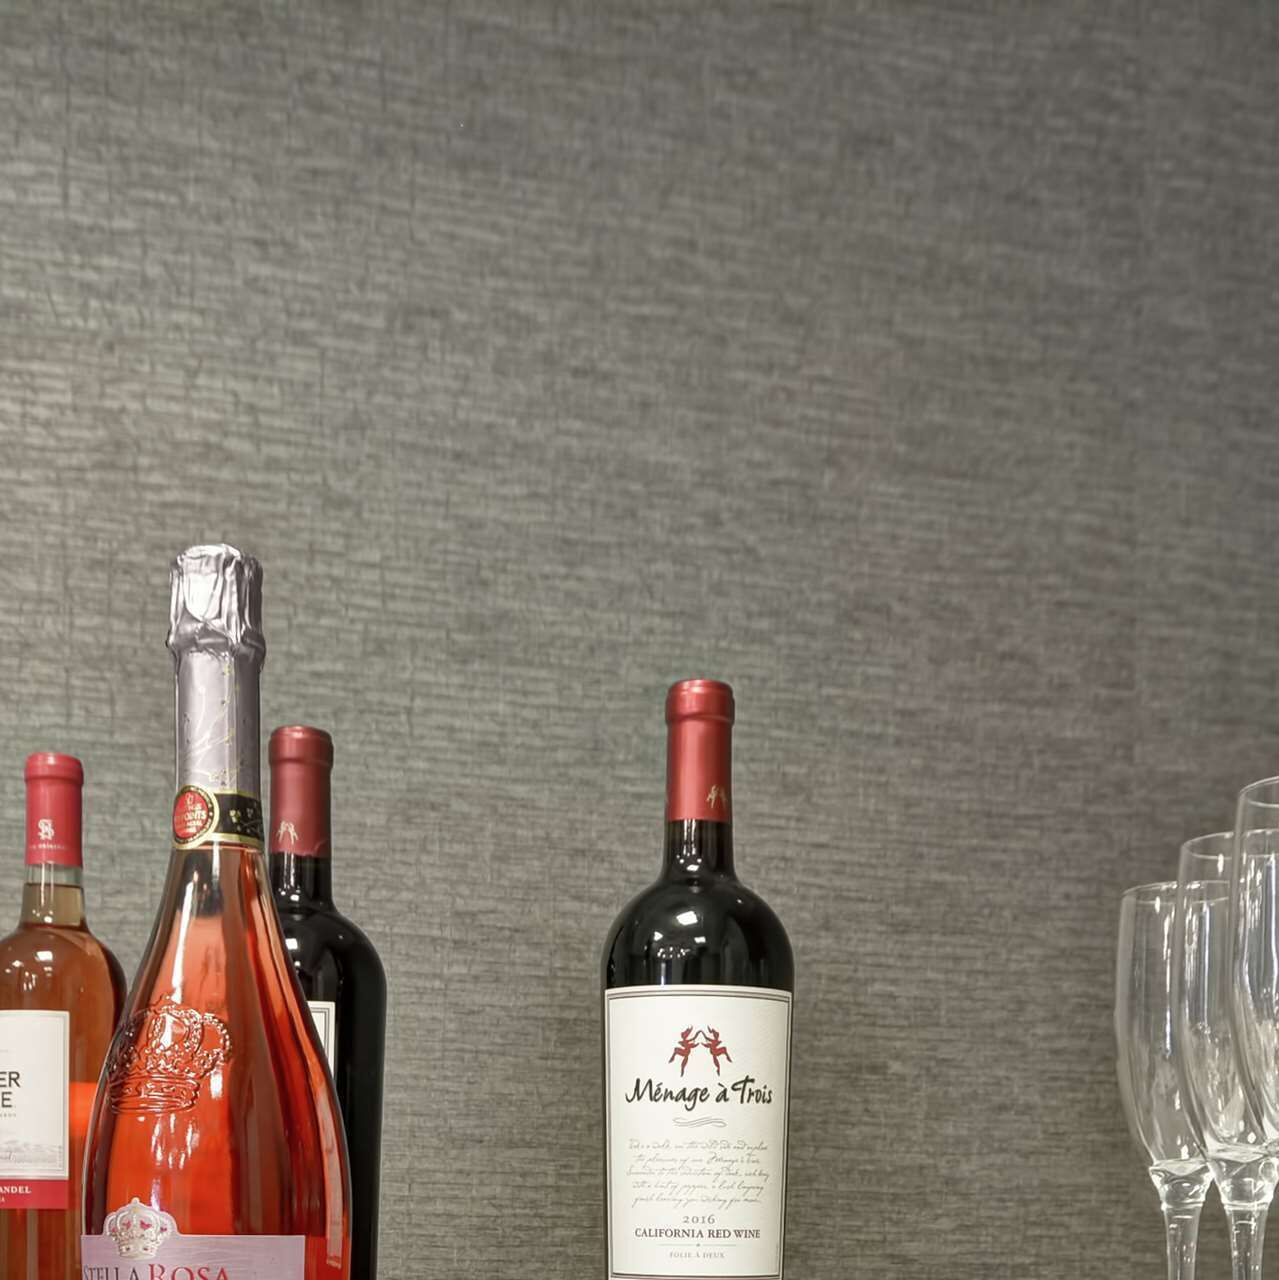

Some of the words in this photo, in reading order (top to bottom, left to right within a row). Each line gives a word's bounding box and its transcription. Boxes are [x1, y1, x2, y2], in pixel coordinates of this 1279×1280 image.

[624, 1078, 710, 1111] Ménage
[715, 1082, 729, 1103] à
[731, 1075, 772, 1104] Trois
[682, 1214, 716, 1224] 2016
[635, 1228, 704, 1239] CALIFORNIA
[708, 1229, 731, 1239] RED
[733, 1229, 761, 1239] WINE
